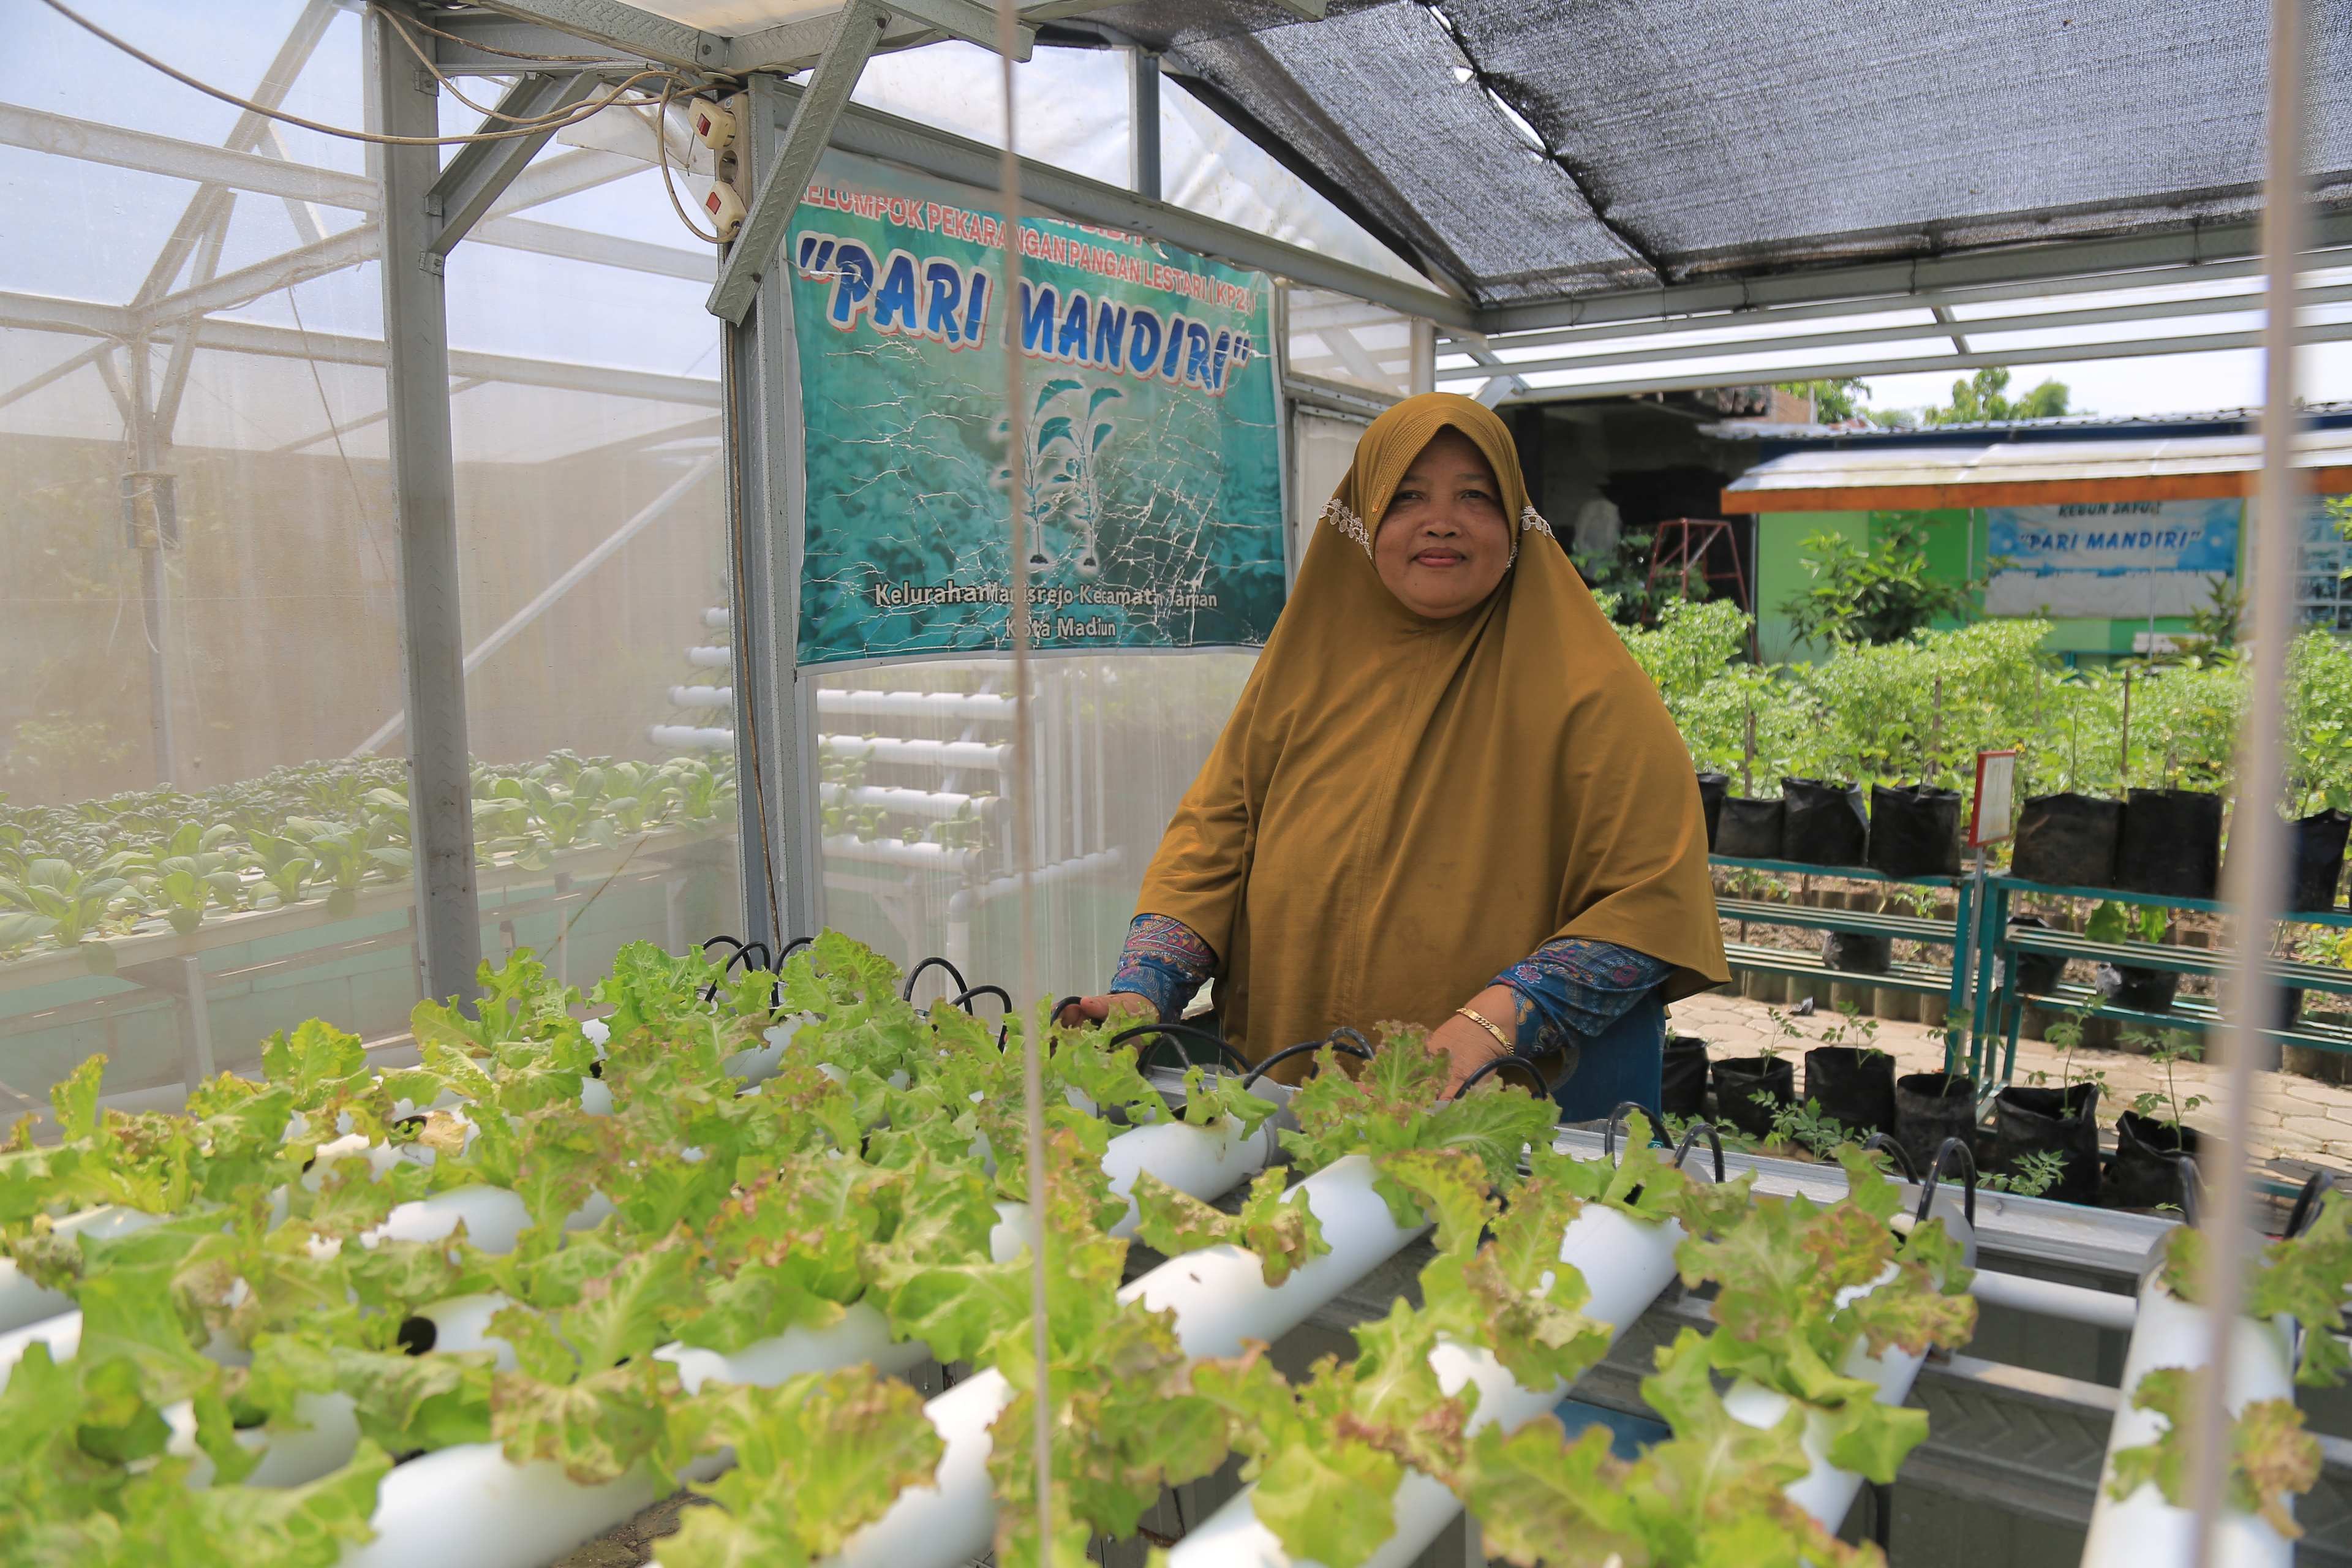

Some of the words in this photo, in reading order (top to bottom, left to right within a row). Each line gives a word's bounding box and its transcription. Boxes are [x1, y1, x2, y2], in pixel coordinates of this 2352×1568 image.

[800, 186, 926, 230] ELOMPOK
[927, 202, 1066, 265] PEKARANGAN
[1069, 238, 1142, 284] PANGAN
[1144, 260, 1207, 301] LESTARI
[797, 232, 989, 352] "PARI
[1001, 277, 1250, 397] MANDIRI"
[2059, 503, 2109, 518] KEBUN
[2021, 532, 2080, 549] "PARI
[2086, 530, 2200, 549] MANDIRI"
[875, 579, 989, 606] Kelurahan
[1079, 584, 1163, 607] Kecamatn
[1057, 616, 1116, 637] Madiun
